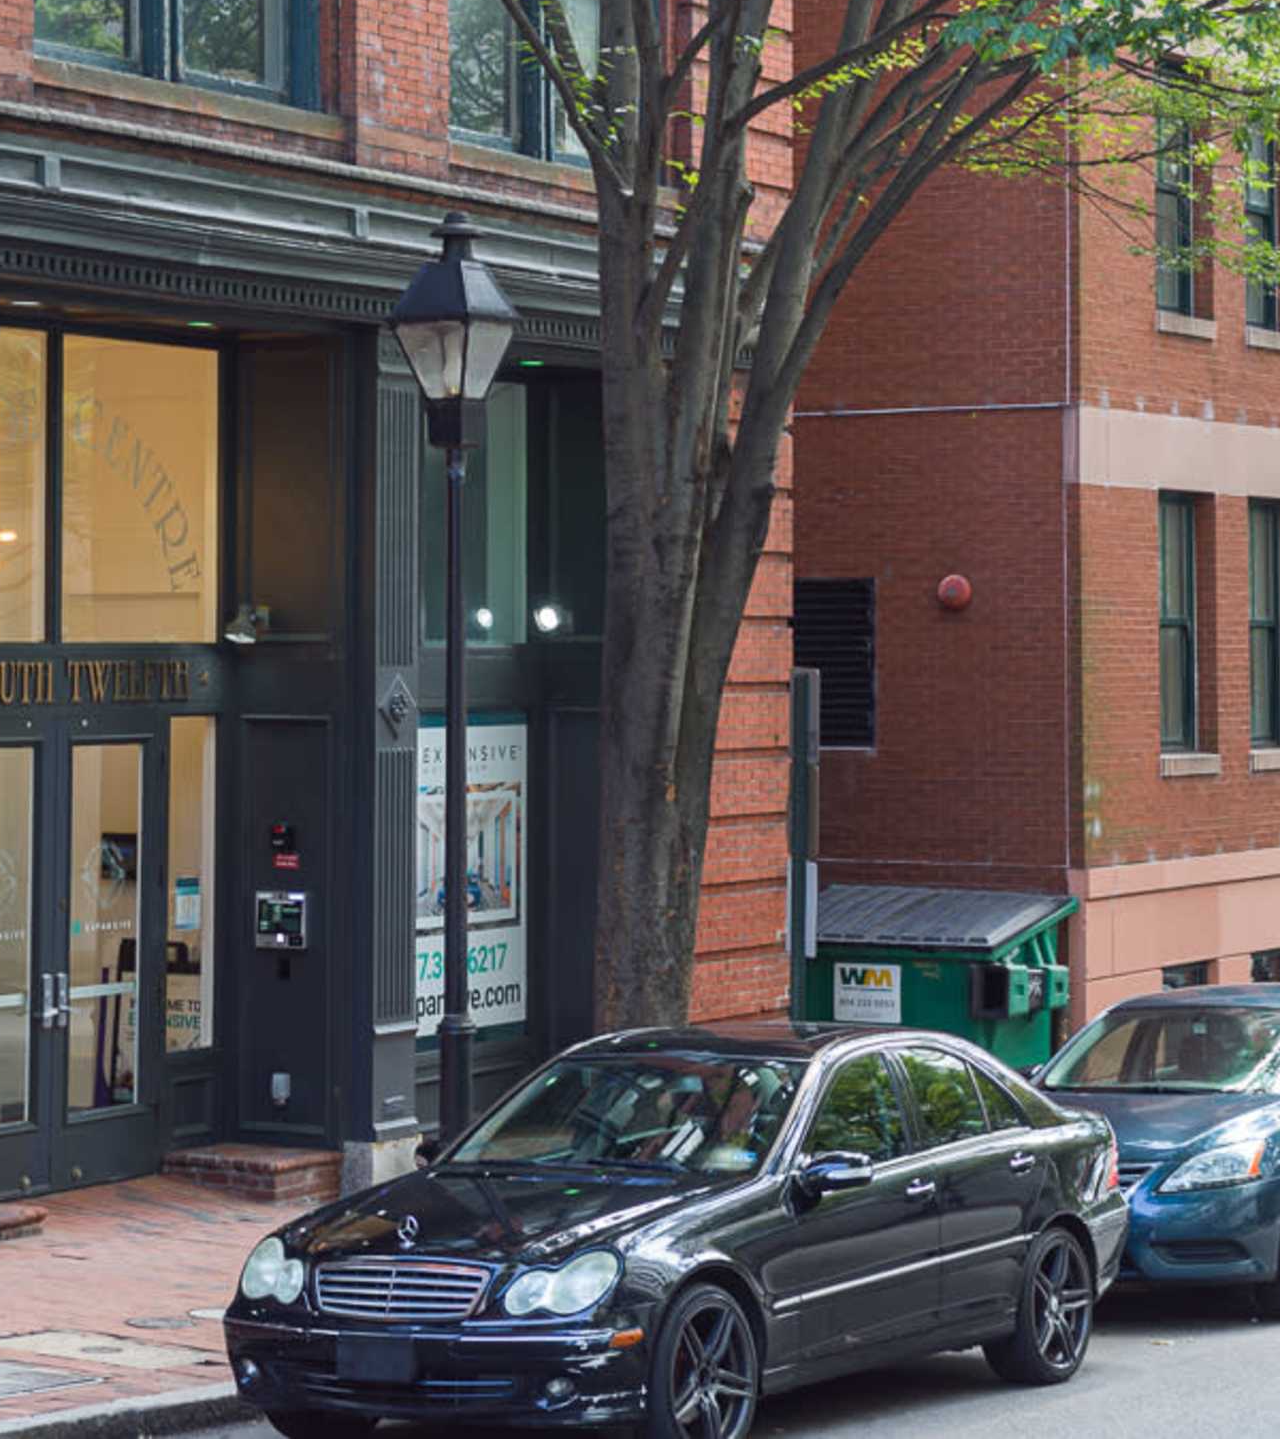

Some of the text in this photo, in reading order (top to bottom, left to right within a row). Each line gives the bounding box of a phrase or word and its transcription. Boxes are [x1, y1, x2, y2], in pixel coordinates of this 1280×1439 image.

[66, 659, 192, 704] TWELFTH
[422, 745, 518, 764] EXNSIVE
[839, 967, 894, 987] WM
